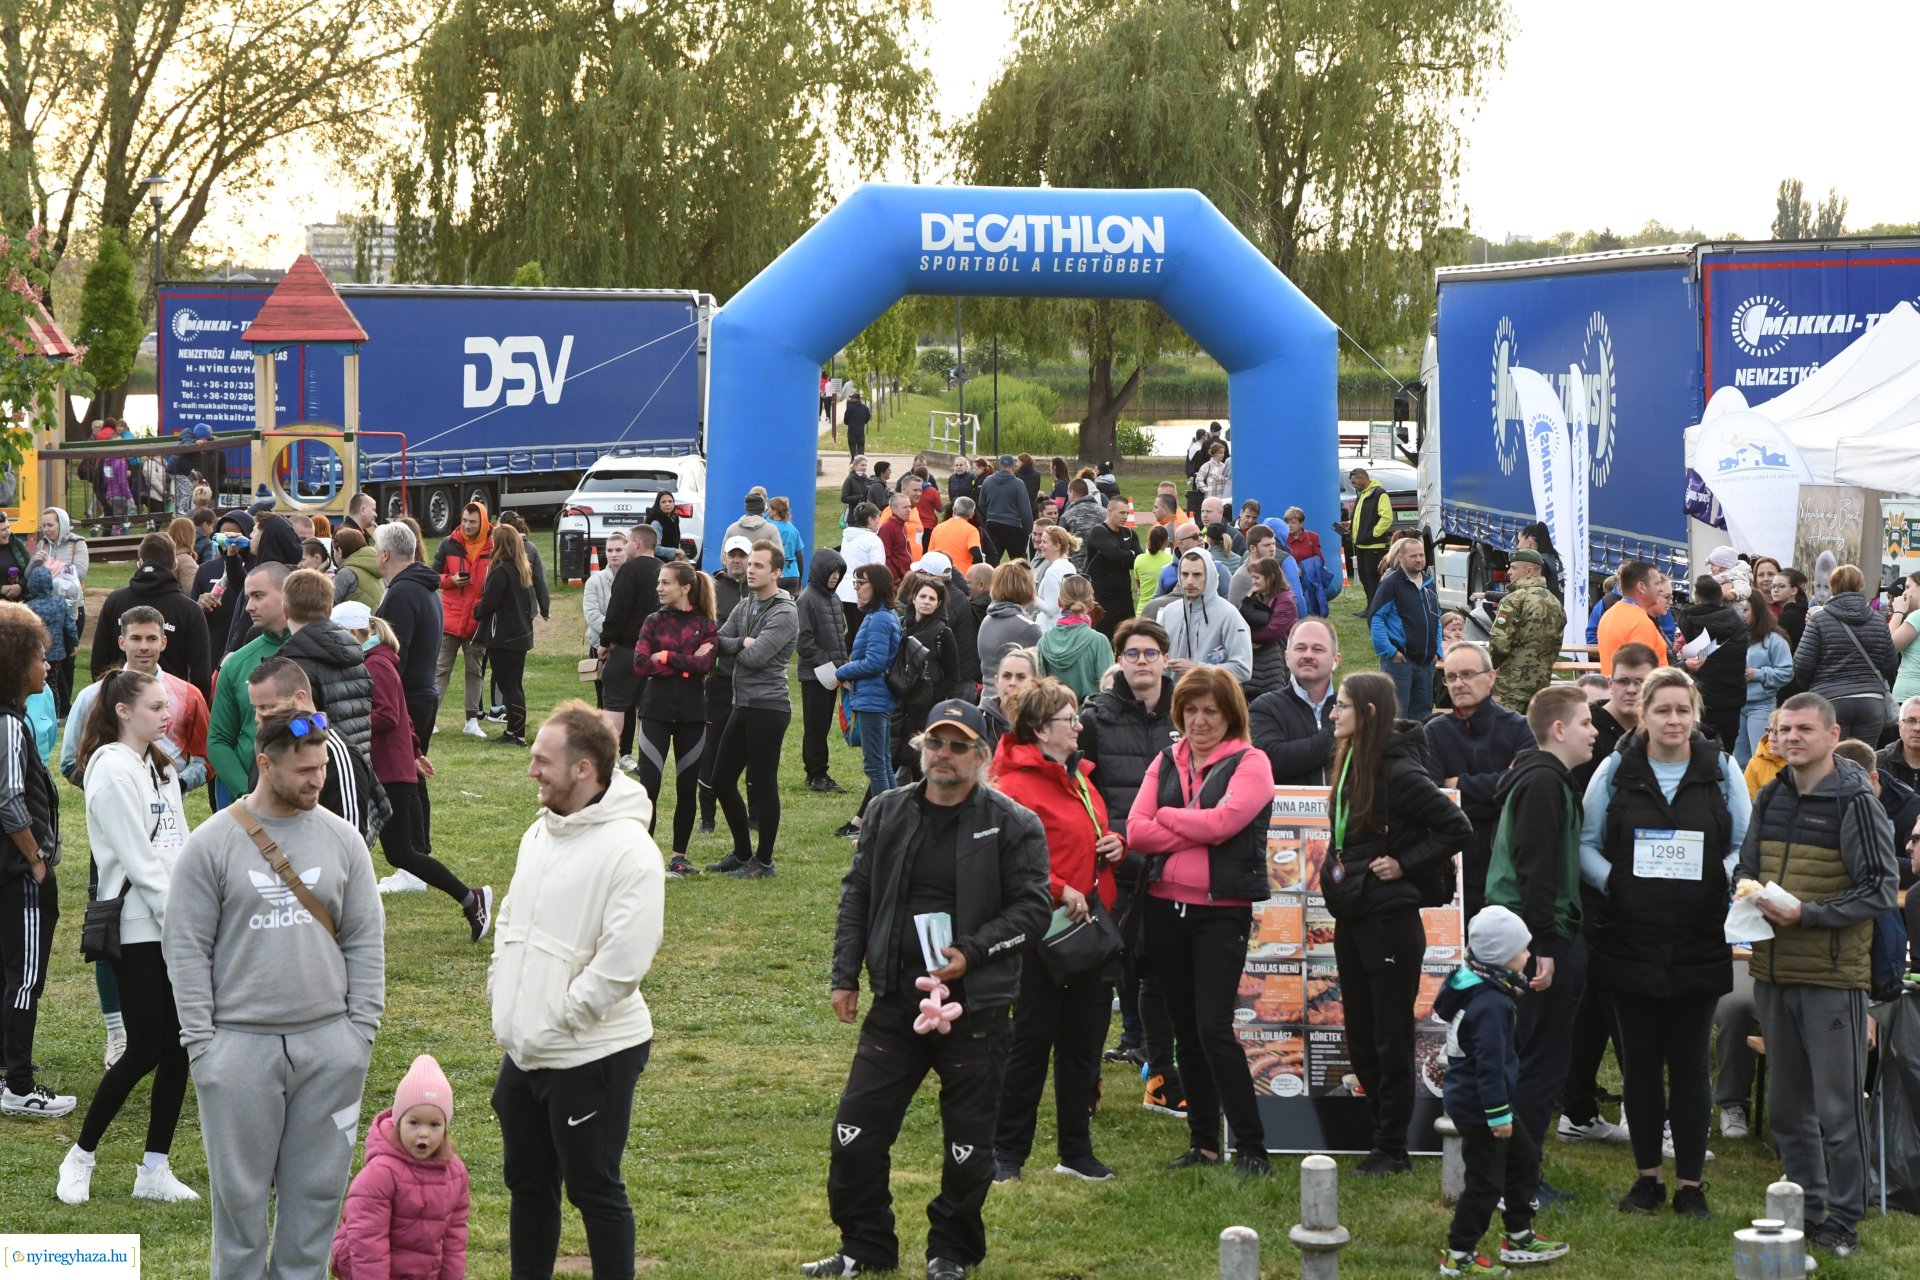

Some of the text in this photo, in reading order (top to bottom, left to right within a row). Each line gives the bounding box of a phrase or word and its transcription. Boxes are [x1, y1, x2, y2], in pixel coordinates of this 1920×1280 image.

[921, 212, 1165, 254] DECATHLON
[920, 253, 1165, 274] SPORTBÓL A LEGTÖBBET
[178, 347, 225, 360] NEMZETKÖZI
[463, 335, 575, 409] DSV
[181, 380, 200, 388] Tel.:
[181, 391, 200, 400] Tel.:
[179, 413, 256, 422] www.makkaitran
[1299, 802, 1328, 813] PARTY
[1266, 830, 1294, 839] RGONYA
[1650, 844, 1686, 860] 1298
[1240, 1029, 1292, 1041] GRILL KOLBÁSZ
[1310, 1031, 1342, 1042] KÖRETEK
